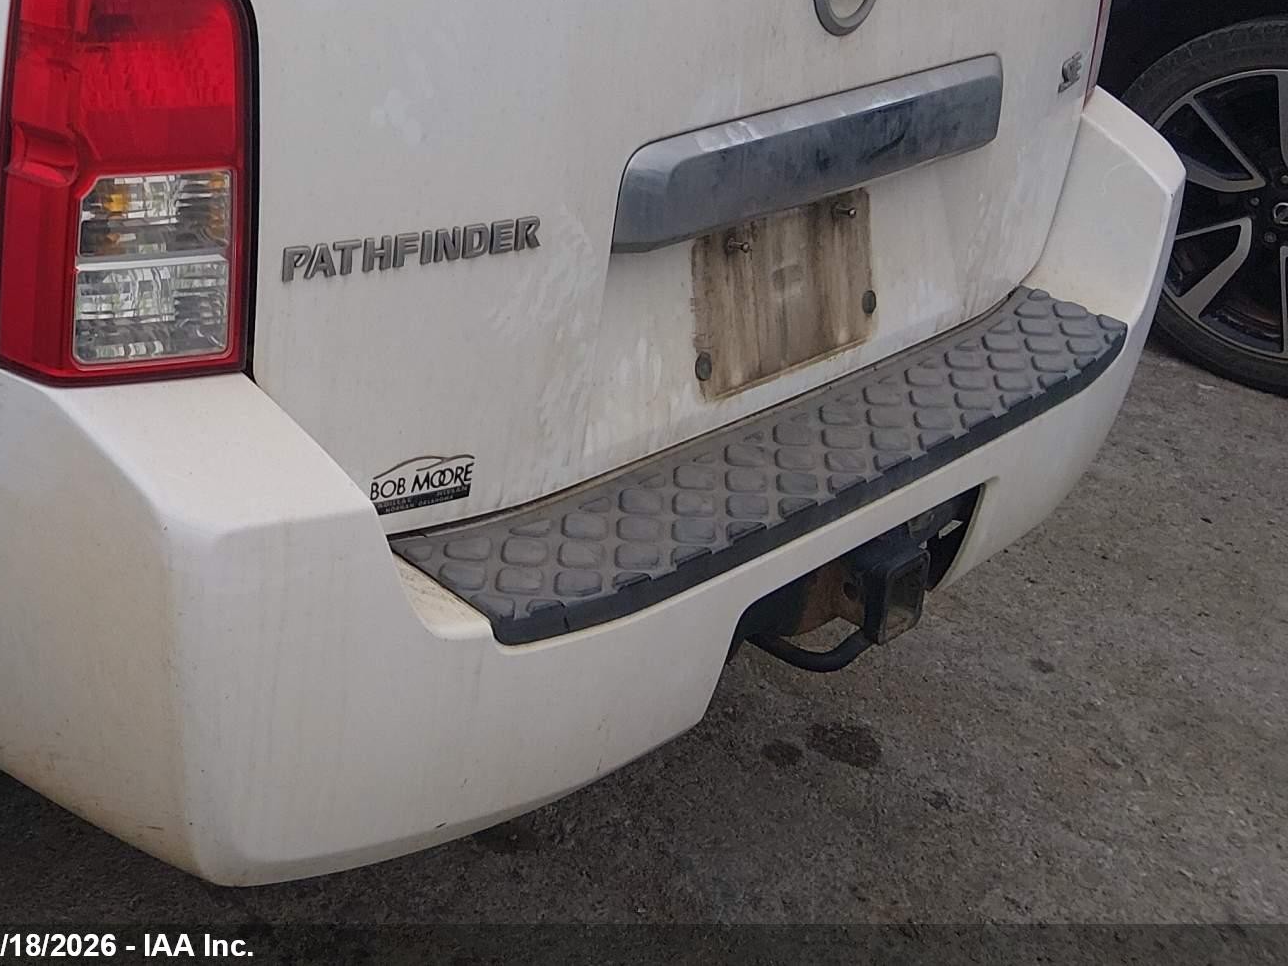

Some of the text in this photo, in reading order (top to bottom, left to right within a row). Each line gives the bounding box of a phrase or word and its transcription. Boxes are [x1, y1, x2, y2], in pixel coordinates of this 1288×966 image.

[281, 215, 542, 283] PATHFINDER
[369, 477, 406, 501] BOB
[411, 462, 475, 494] MOORE
